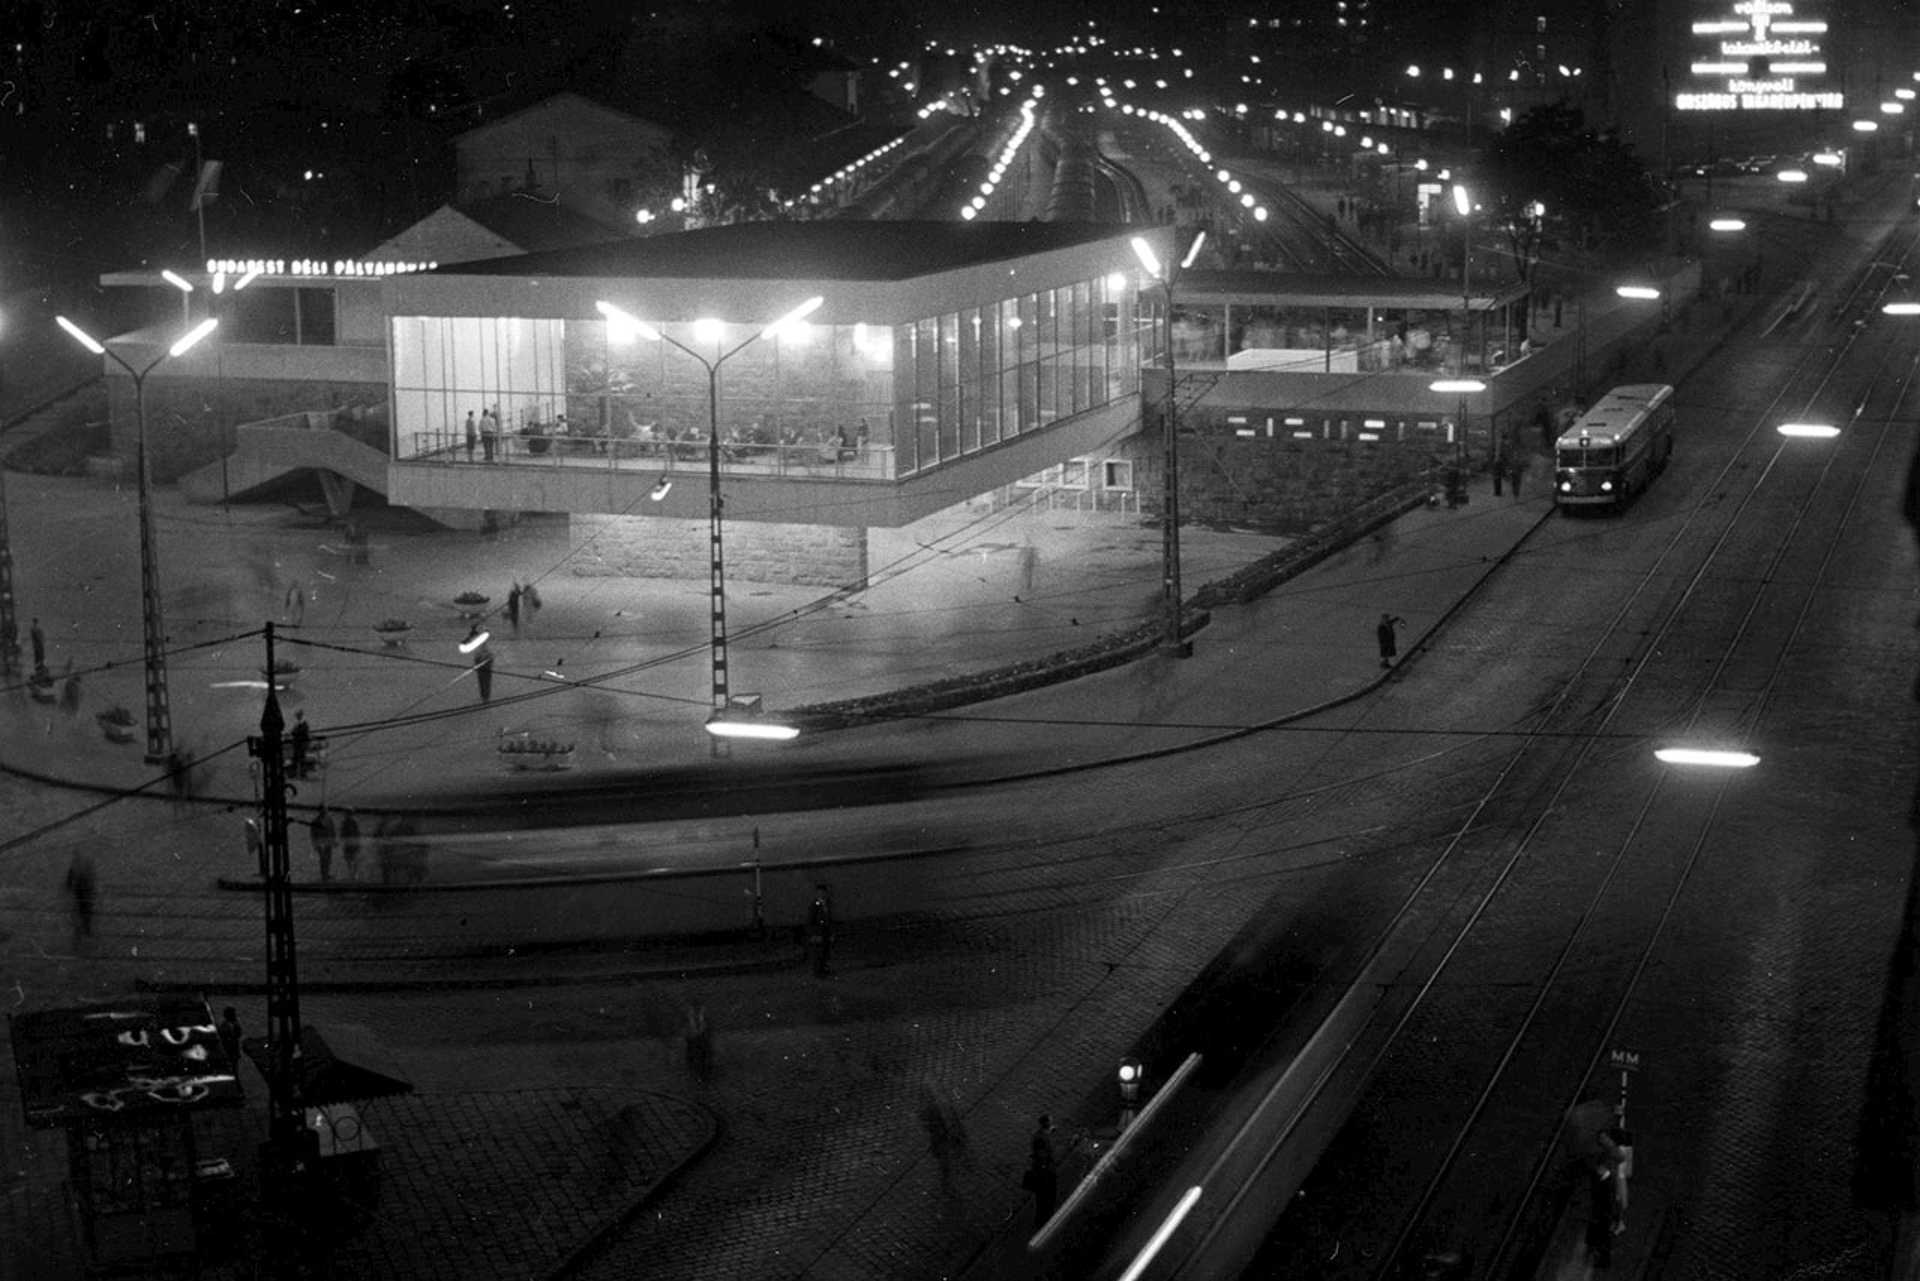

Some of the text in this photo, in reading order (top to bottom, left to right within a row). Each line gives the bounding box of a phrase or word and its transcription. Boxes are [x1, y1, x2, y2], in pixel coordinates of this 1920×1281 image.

[207, 259, 437, 275] BUDAPEST DÉLI PÁLYAUDV
